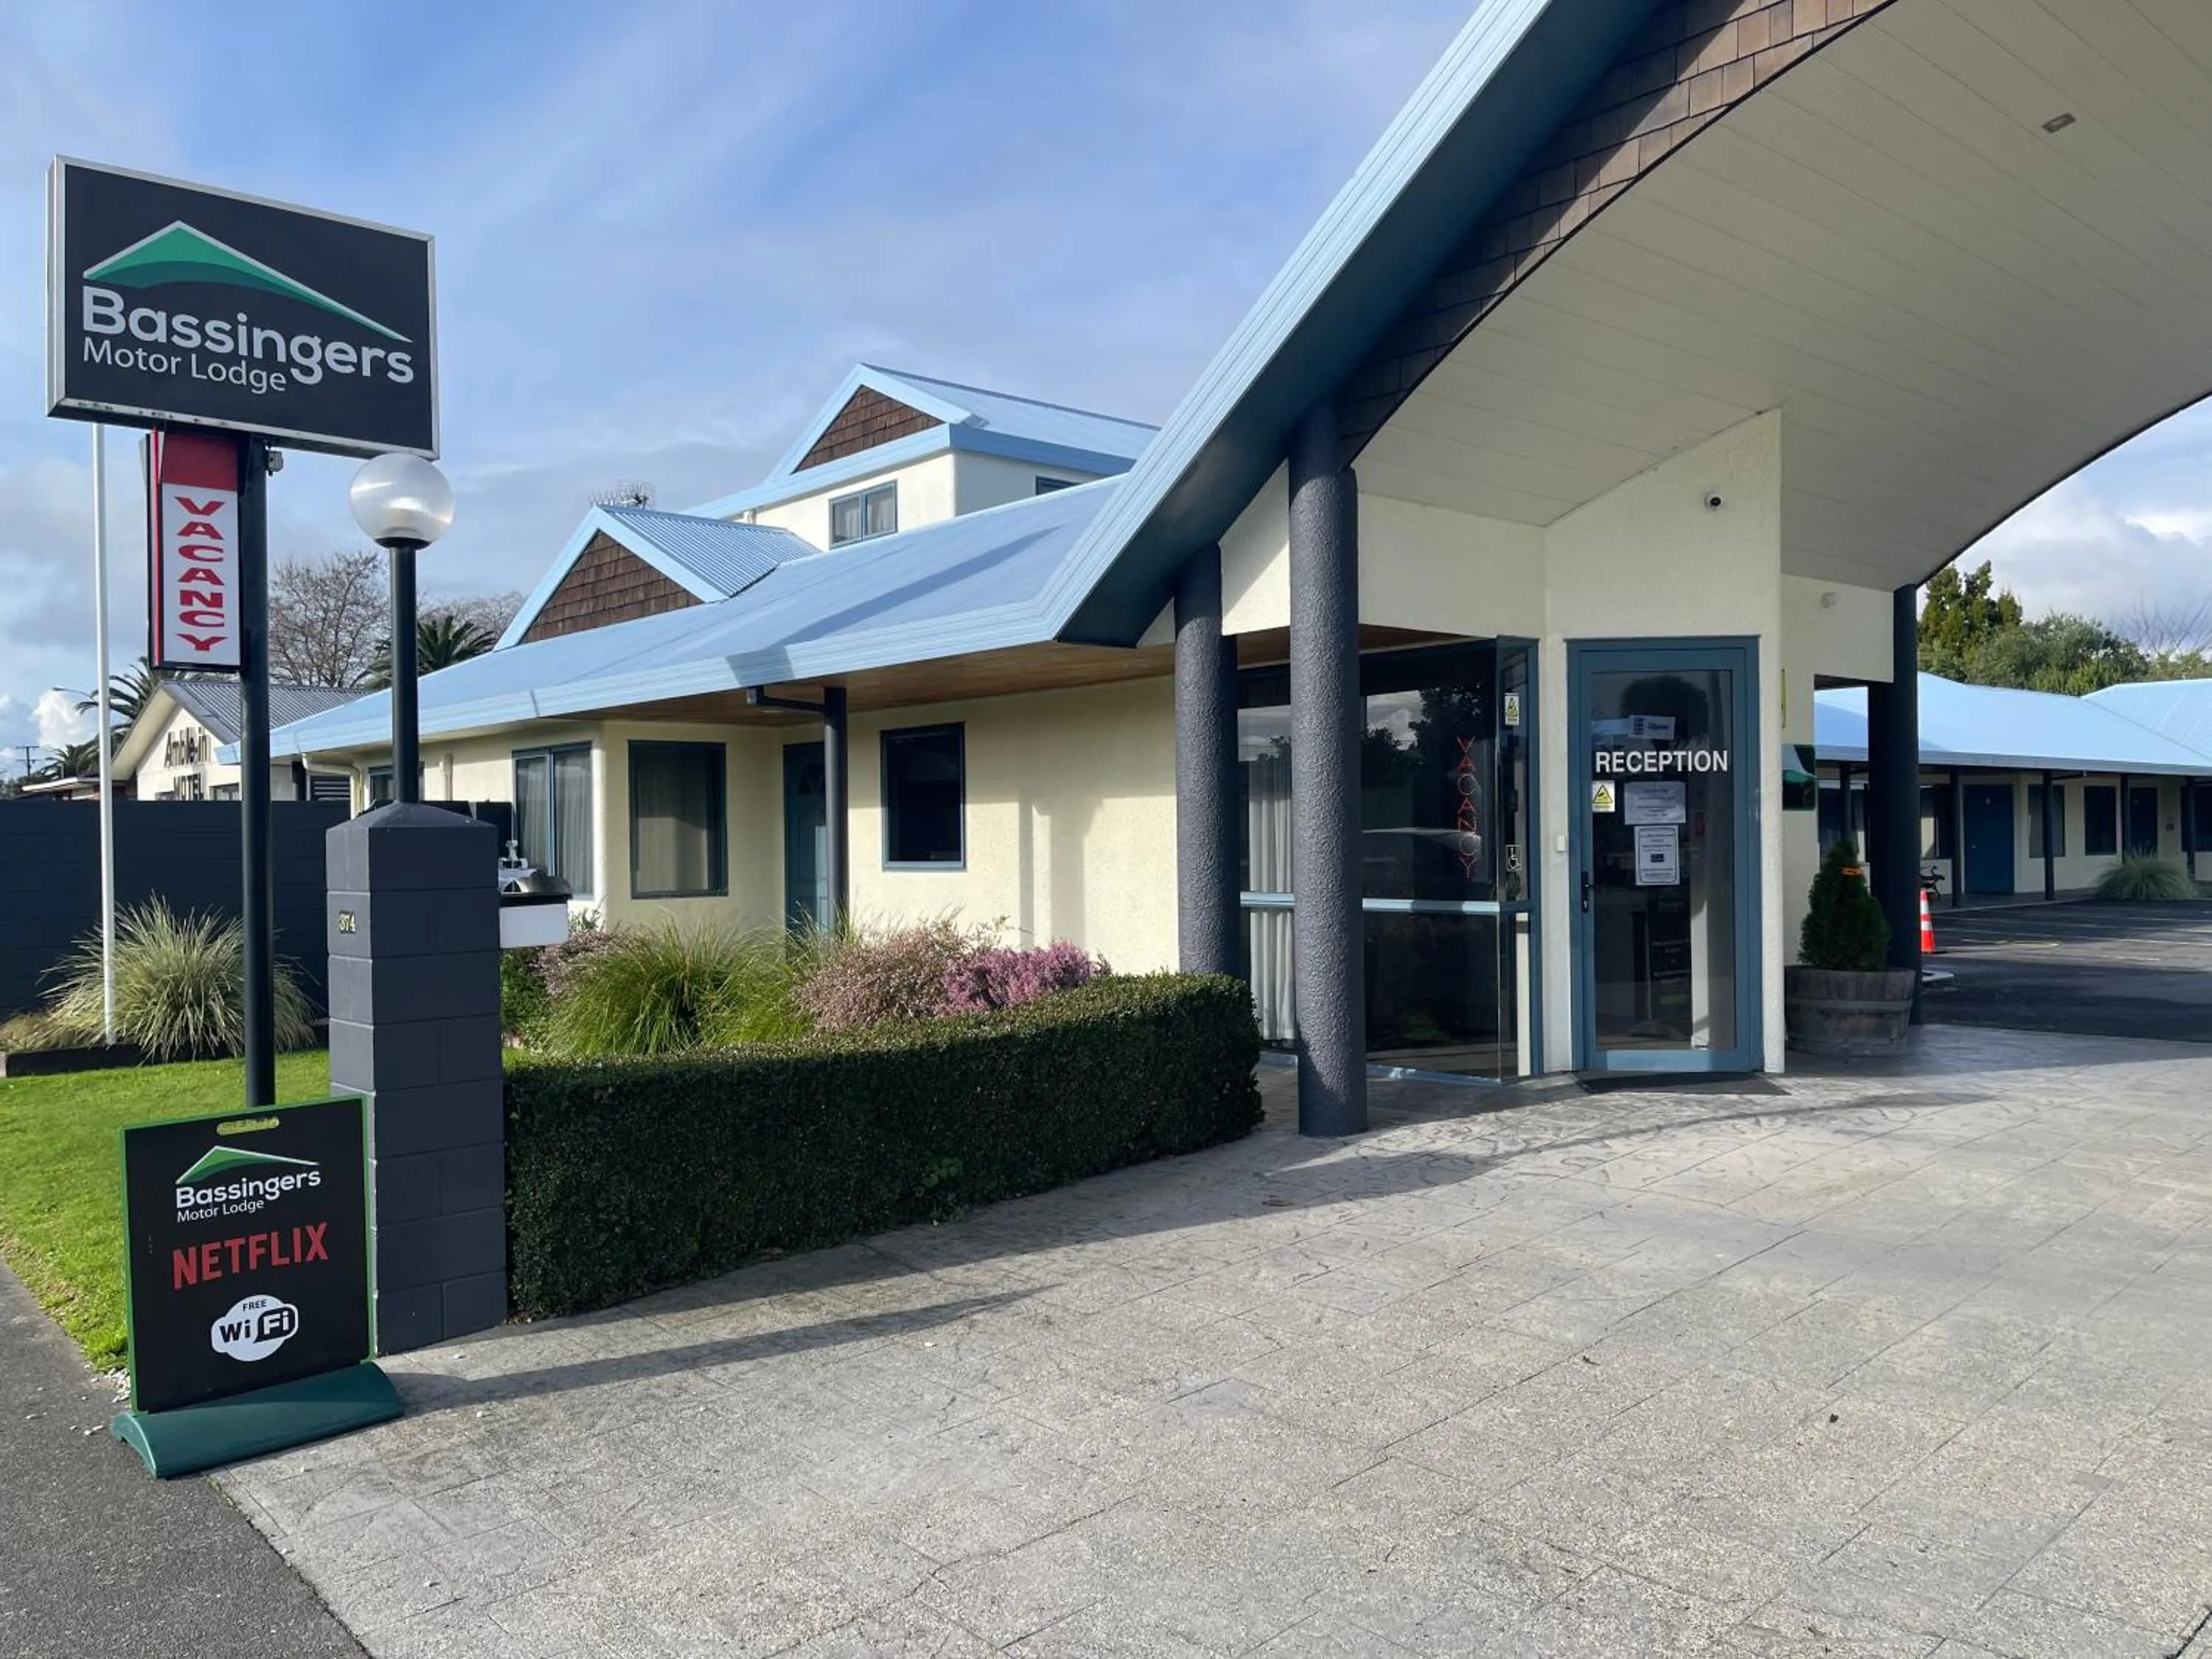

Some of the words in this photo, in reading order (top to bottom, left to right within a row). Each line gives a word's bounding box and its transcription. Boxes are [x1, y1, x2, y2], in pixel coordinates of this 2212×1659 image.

[83, 286, 413, 384] Bassingers
[83, 337, 181, 375] Motor
[192, 354, 286, 394] Lodge
[174, 495, 229, 651] VACANCY
[1595, 750, 1728, 772] RECEPTION
[1455, 735, 1479, 878] VACANCY
[175, 1170, 321, 1208] Bassingers
[177, 1207, 219, 1223] Motor
[223, 1200, 265, 1215] Lodge
[173, 1222, 329, 1290] NETFLIX
[243, 1299, 268, 1312] FREE
